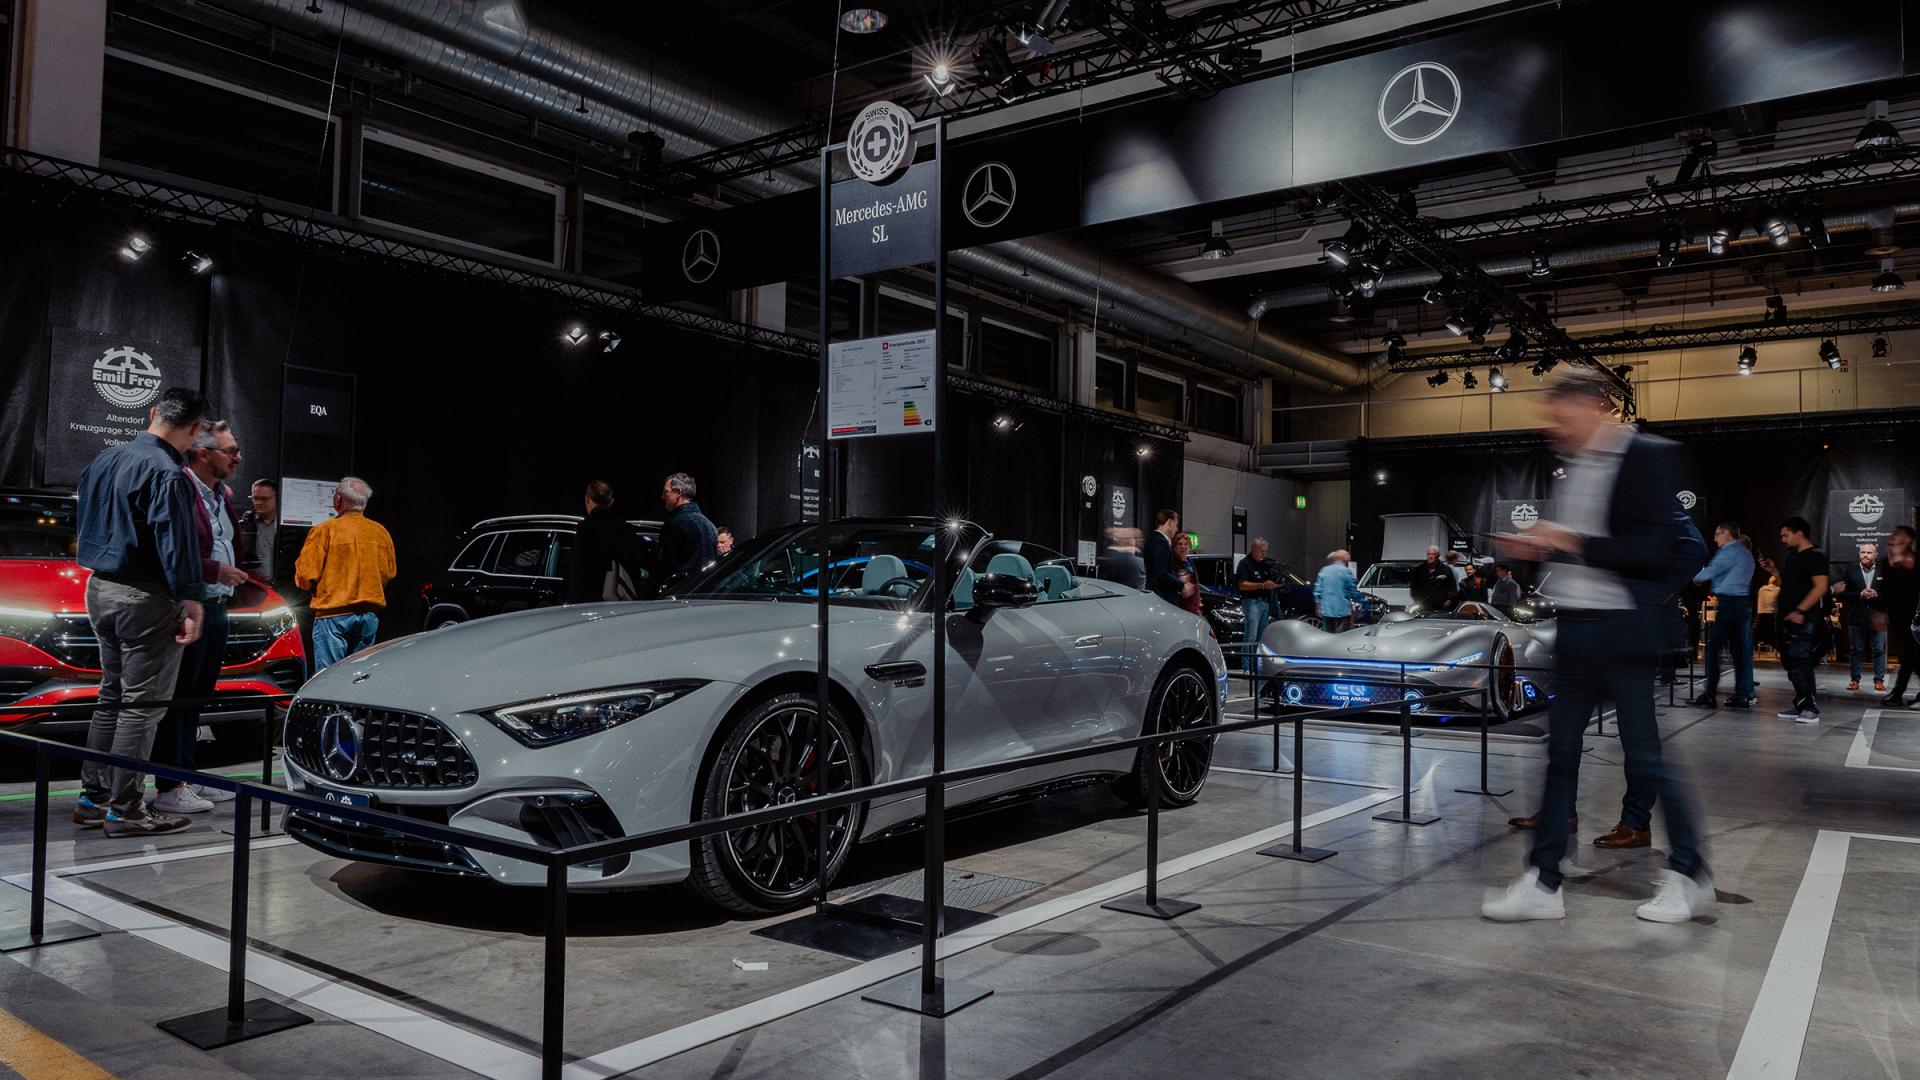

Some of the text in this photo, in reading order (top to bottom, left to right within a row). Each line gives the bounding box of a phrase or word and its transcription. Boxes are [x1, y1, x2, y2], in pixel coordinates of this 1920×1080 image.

[865, 106, 889, 121] SWISS
[835, 190, 928, 226] Mercedes-AMG
[872, 224, 889, 244] SL
[92, 369, 162, 390] Emil Frey
[310, 404, 328, 416] EQA
[106, 413, 145, 425] Altendorf
[70, 422, 123, 436] Kreuzgarage
[1334, 684, 1365, 697] EQ
